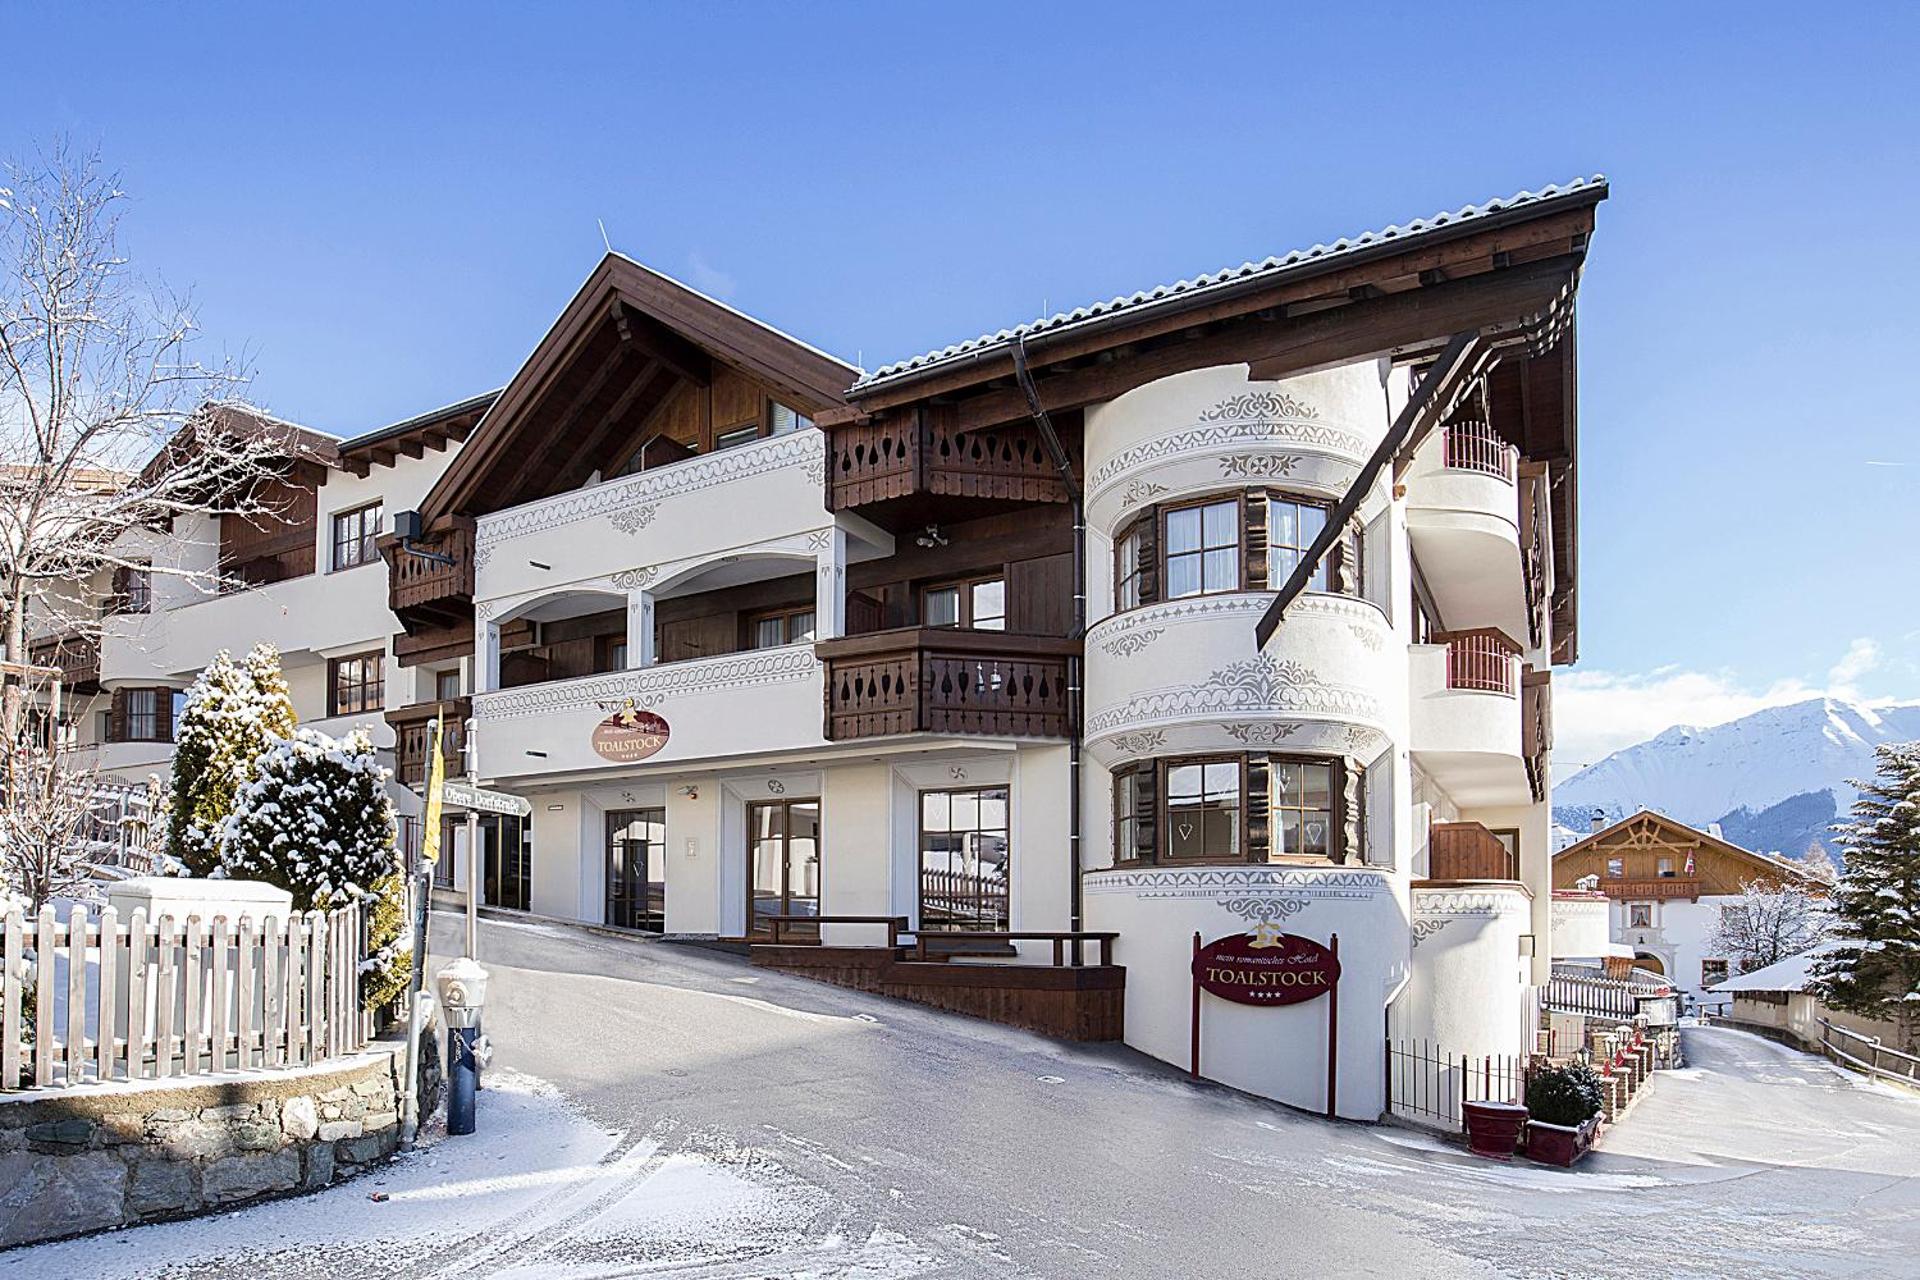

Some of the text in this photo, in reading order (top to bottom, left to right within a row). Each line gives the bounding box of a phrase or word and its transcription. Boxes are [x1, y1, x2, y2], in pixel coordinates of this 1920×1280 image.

[598, 736, 661, 752] TOALSTOCK
[445, 787, 472, 803] Obere
[1215, 954, 1235, 962] mein
[1287, 952, 1319, 965] Hotel
[1206, 967, 1328, 986] TOALSTOCK
